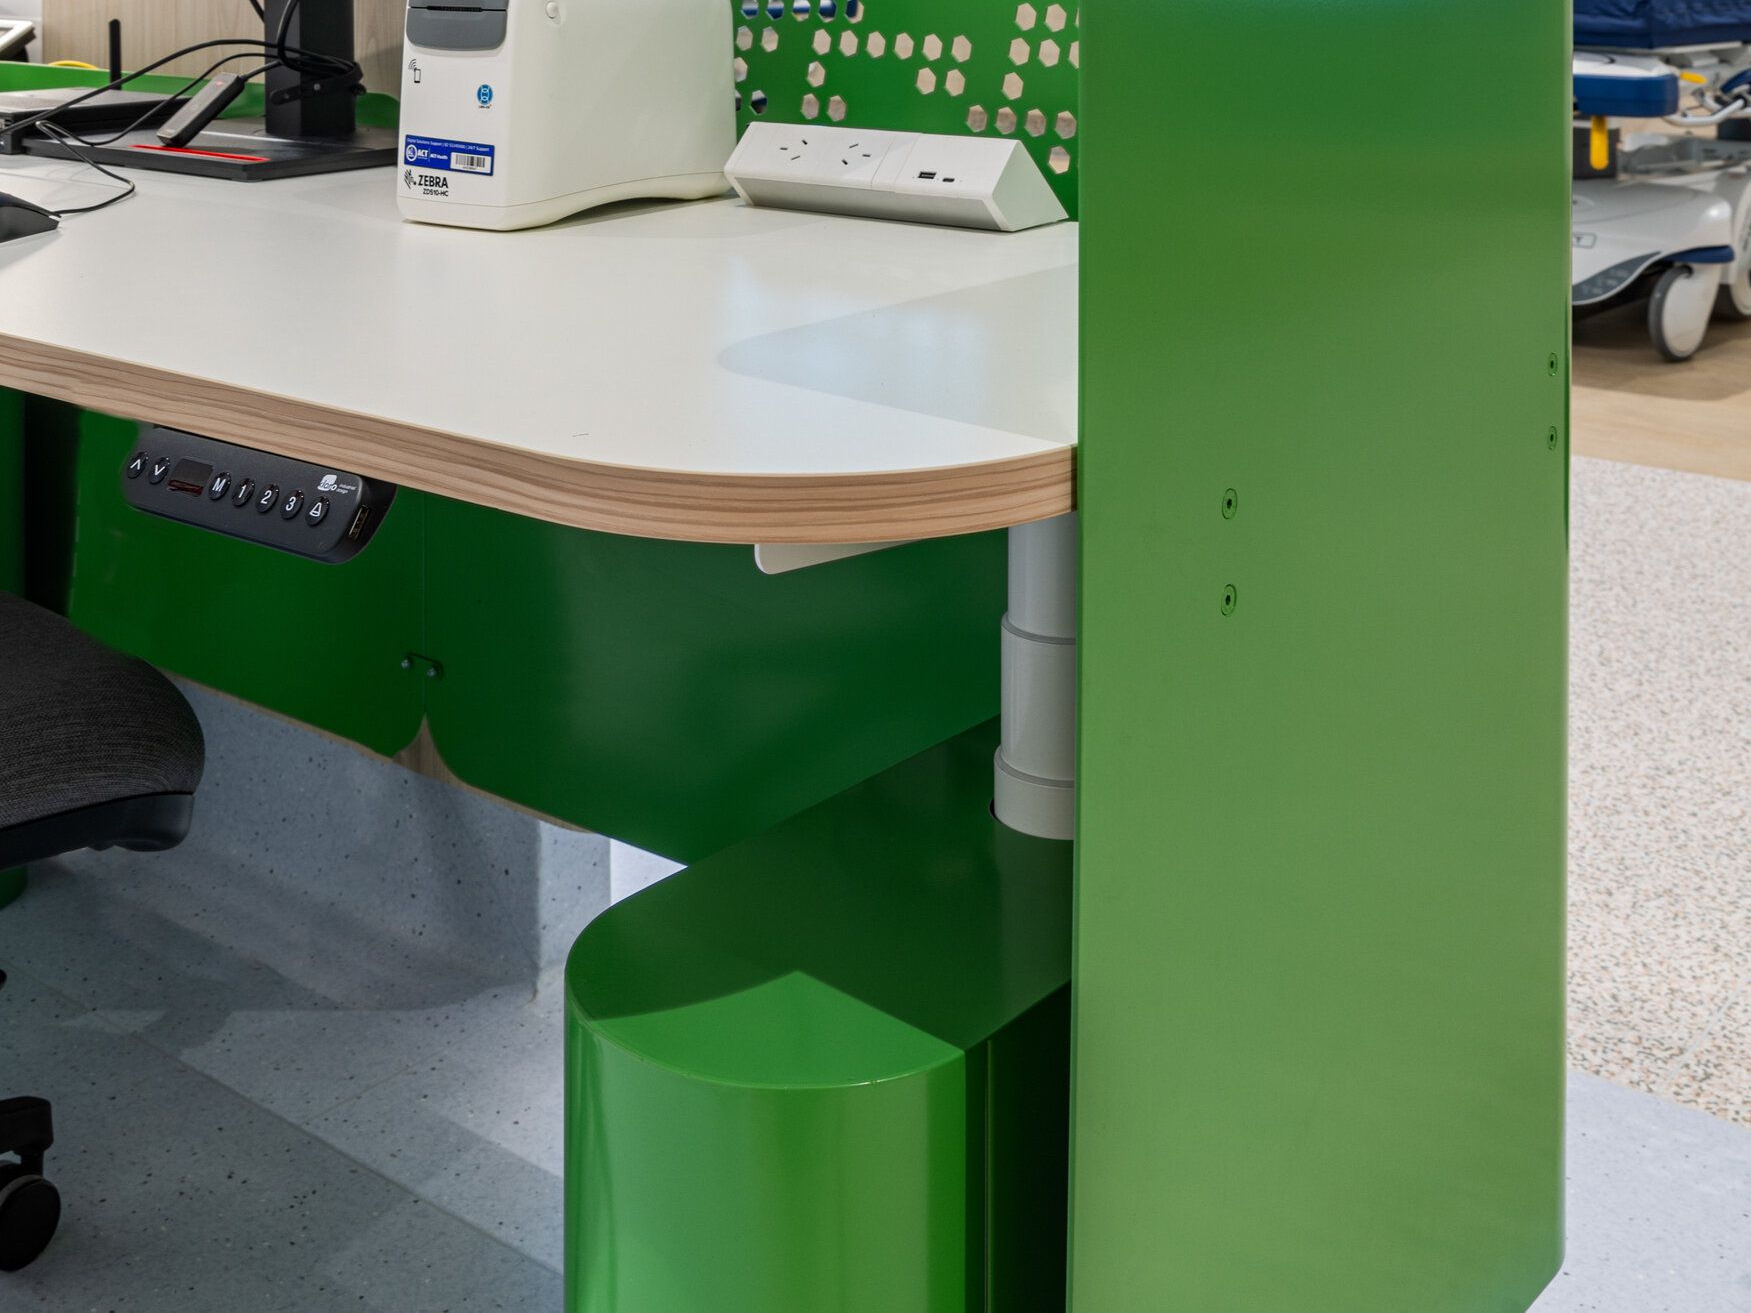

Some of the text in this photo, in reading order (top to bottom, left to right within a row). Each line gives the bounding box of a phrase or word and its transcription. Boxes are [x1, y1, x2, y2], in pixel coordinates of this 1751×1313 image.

[417, 149, 429, 157] ACT
[418, 175, 449, 189] ZEBRA
[423, 188, 449, 197] ZD510-HC
[212, 477, 297, 511] M 1 2 3
